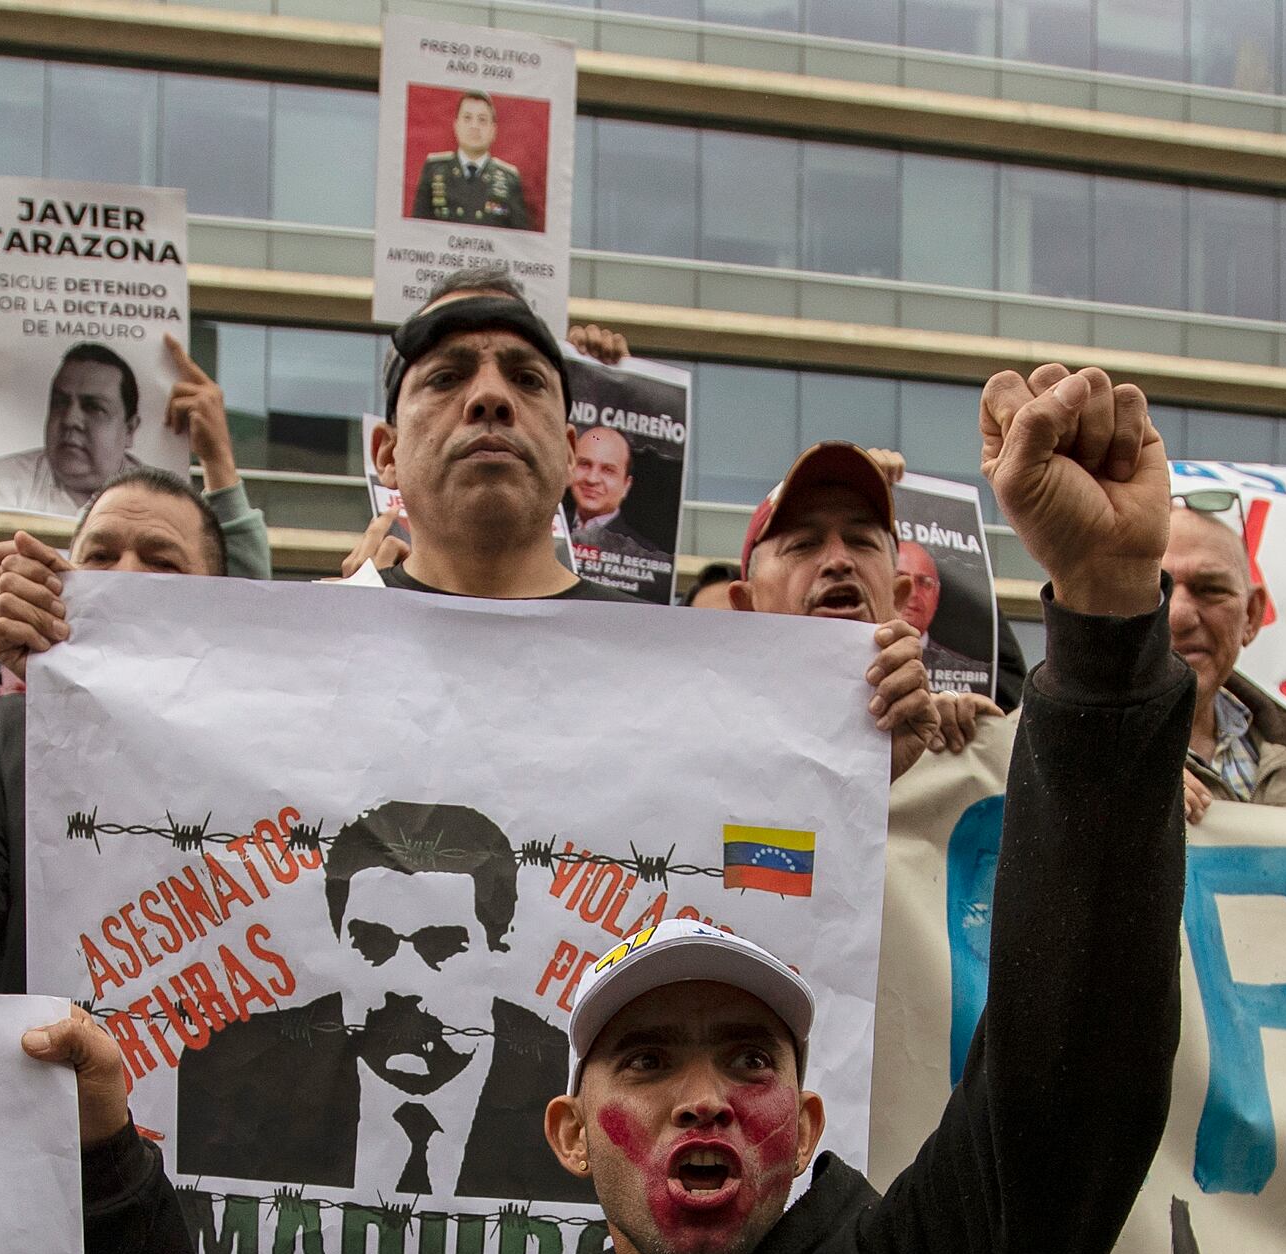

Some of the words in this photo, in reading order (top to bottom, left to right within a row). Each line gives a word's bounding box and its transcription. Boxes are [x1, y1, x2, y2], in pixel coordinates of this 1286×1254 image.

[420, 38, 471, 57] PRESO
[18, 197, 145, 232] JAVIER
[64, 275, 167, 298] DETENIDO
[33, 298, 57, 314] LA
[63, 299, 181, 321] DICTADURA
[22, 318, 49, 335] DE
[55, 321, 146, 340] MADURO
[600, 406, 685, 445] CARREÑO
[916, 521, 982, 555] DÁVILA
[584, 559, 602, 573] SU
[604, 563, 656, 581] FAMILIA
[600, 551, 622, 565] SIN
[623, 555, 673, 574] RECIBIR
[929, 681, 973, 693] AMILIA
[935, 669, 989, 684] RECIBIR
[78, 805, 323, 1001] ASESINATOS
[105, 922, 297, 1097] RTURAS
